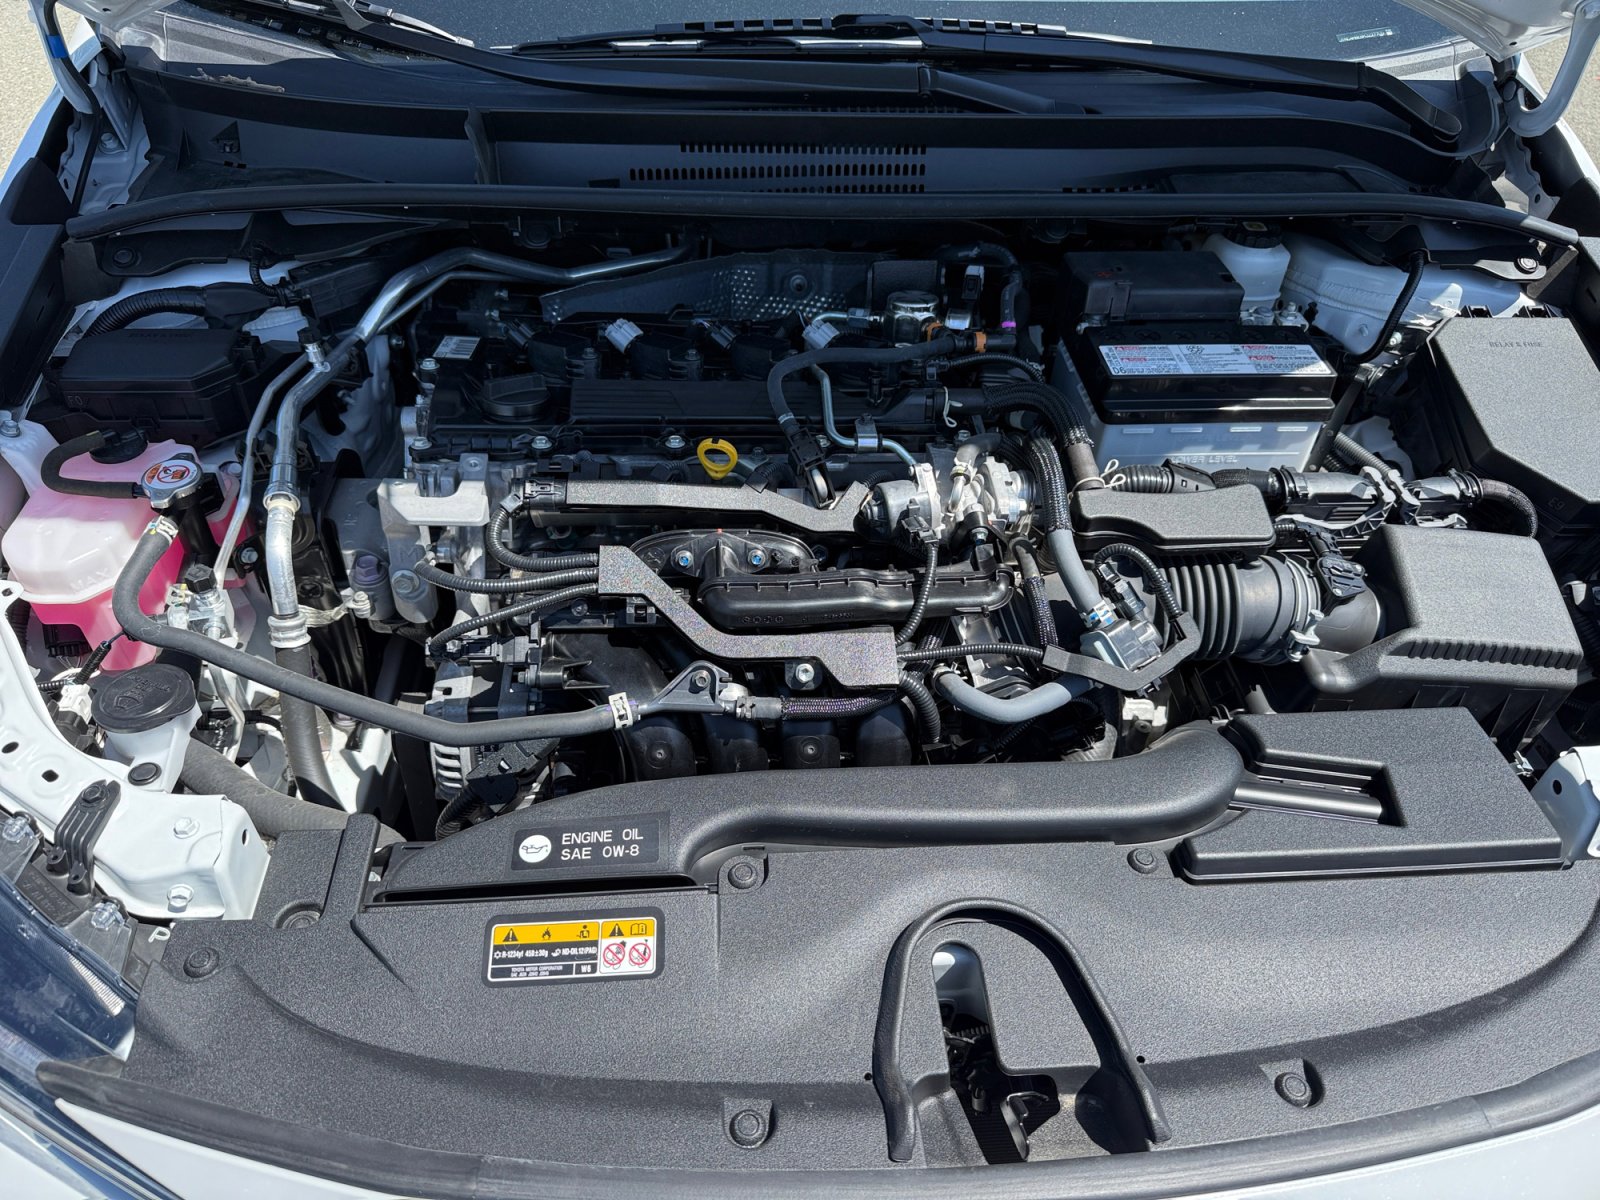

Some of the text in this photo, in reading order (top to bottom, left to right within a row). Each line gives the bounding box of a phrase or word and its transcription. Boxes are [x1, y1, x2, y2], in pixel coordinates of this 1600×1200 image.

[1171, 455, 1239, 464] LOWER LEVEL
[561, 828, 644, 845] ENGINE OIL
[560, 844, 640, 861] SAE 0W-8
